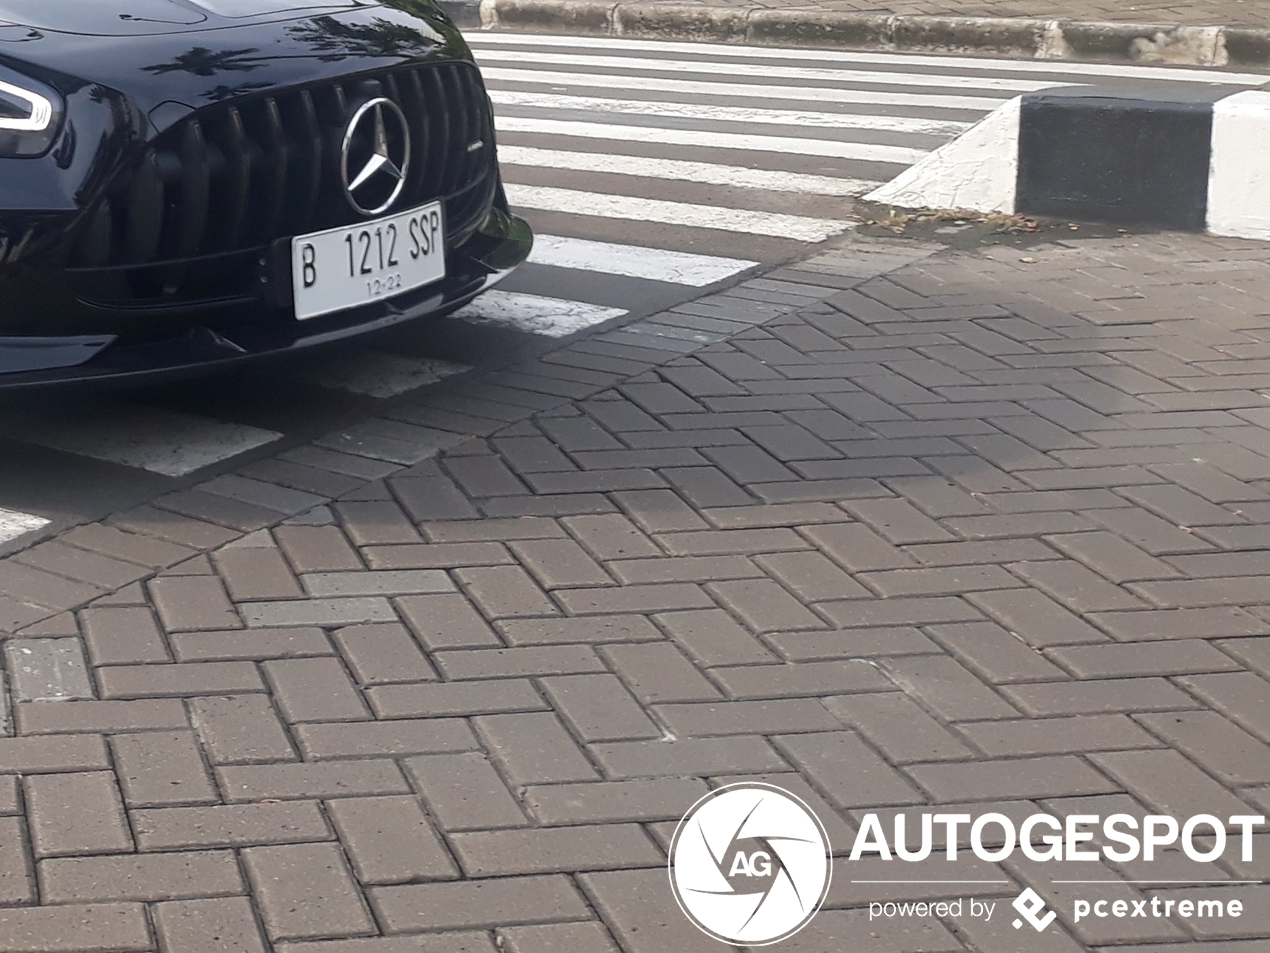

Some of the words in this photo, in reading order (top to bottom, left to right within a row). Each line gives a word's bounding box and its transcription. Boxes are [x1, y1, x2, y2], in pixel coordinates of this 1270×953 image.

[302, 243, 316, 288] B
[345, 223, 398, 277] 1212
[409, 210, 439, 260] SSP
